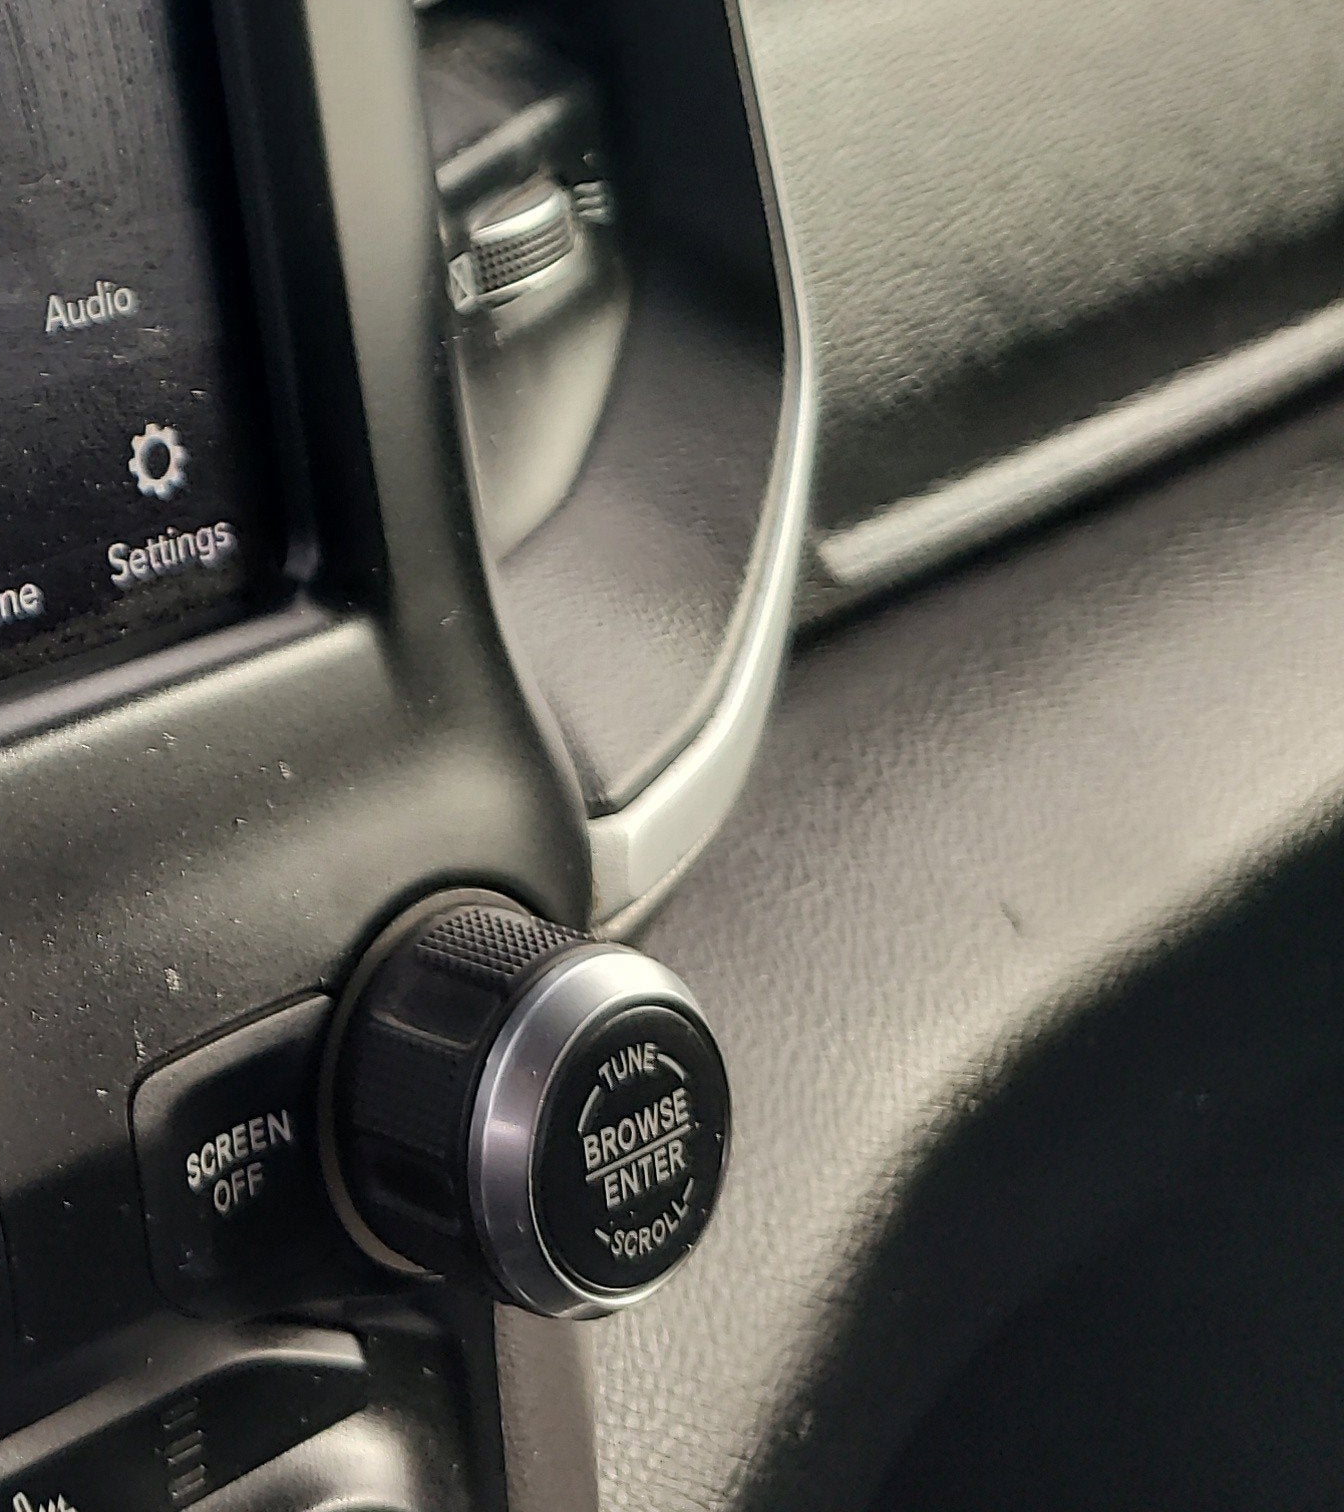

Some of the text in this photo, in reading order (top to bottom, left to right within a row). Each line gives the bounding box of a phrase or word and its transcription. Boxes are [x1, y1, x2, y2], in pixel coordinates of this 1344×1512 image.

[45, 280, 135, 334] Audio
[108, 519, 234, 588] Settings
[599, 1042, 657, 1091] TUNE
[186, 1109, 292, 1189] SCREEN
[583, 1088, 690, 1168] BROWSE
[213, 1162, 265, 1214] OFF
[604, 1143, 686, 1210] ENTER
[611, 1199, 690, 1258] SCROLL
